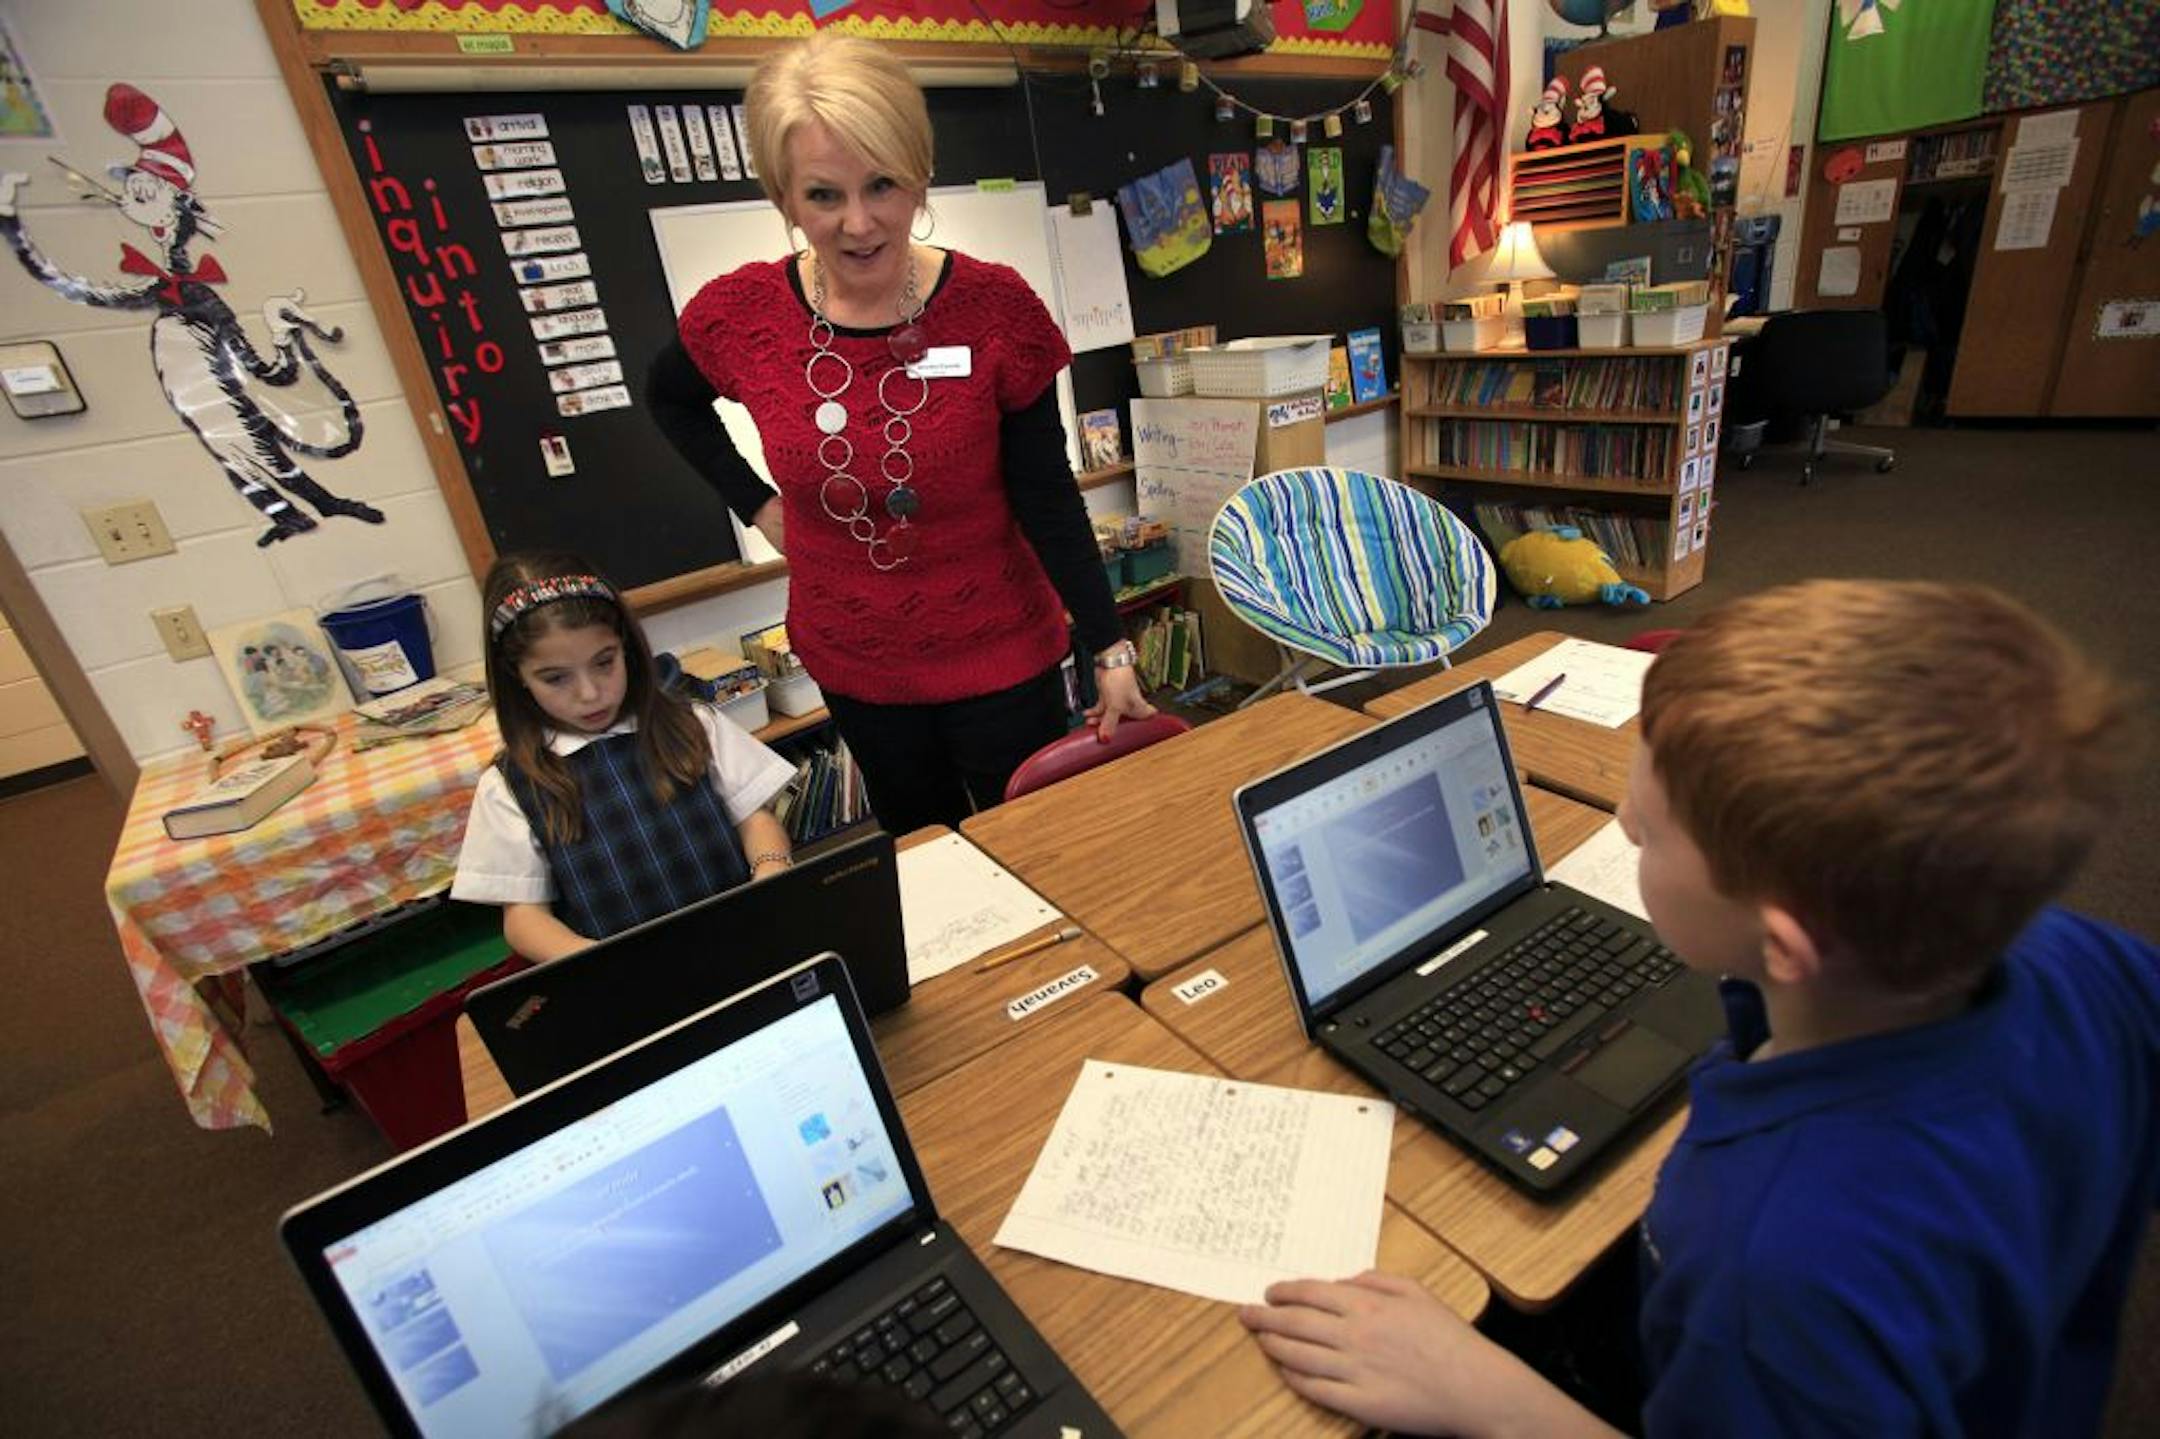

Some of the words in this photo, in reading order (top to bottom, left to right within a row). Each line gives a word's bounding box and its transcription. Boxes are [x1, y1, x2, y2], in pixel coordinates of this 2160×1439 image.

[500, 117, 537, 132] arrival
[517, 175, 558, 190] religion
[534, 234, 573, 246] recess
[357, 119, 482, 444] inquiry
[423, 178, 505, 373] into
[1011, 970, 1094, 1012] Savanah
[1179, 976, 1218, 1001] Leo
